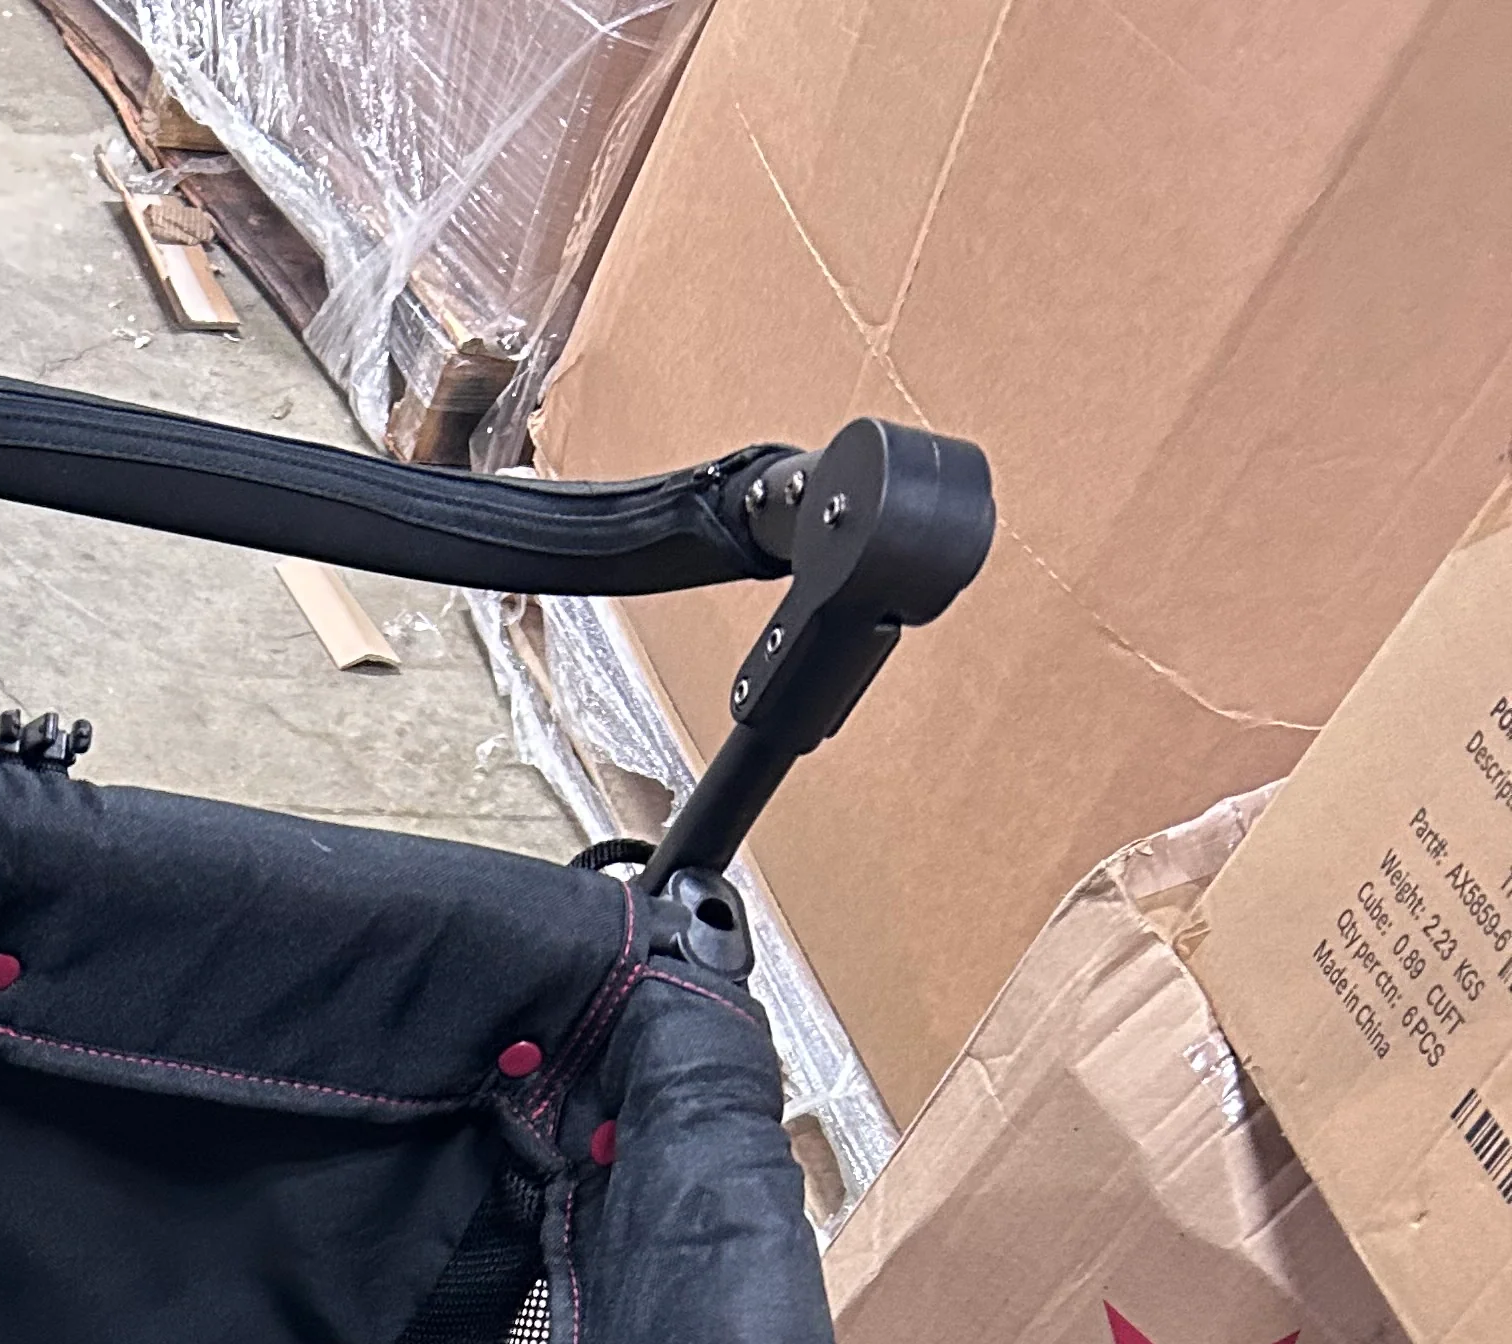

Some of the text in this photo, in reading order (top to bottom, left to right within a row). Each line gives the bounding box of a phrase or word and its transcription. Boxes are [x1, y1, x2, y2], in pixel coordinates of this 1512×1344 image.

[1380, 848, 1486, 1002] Weight: 2.23 KGS
[1409, 806, 1512, 951] Part#: AX5859-6
[1313, 939, 1391, 1060] Made in China
[1338, 908, 1363, 951] Qty
[1353, 938, 1383, 975] per
[1375, 970, 1403, 1010] ctn:
[1357, 881, 1467, 1036] Cube: 0.89 CUFT
